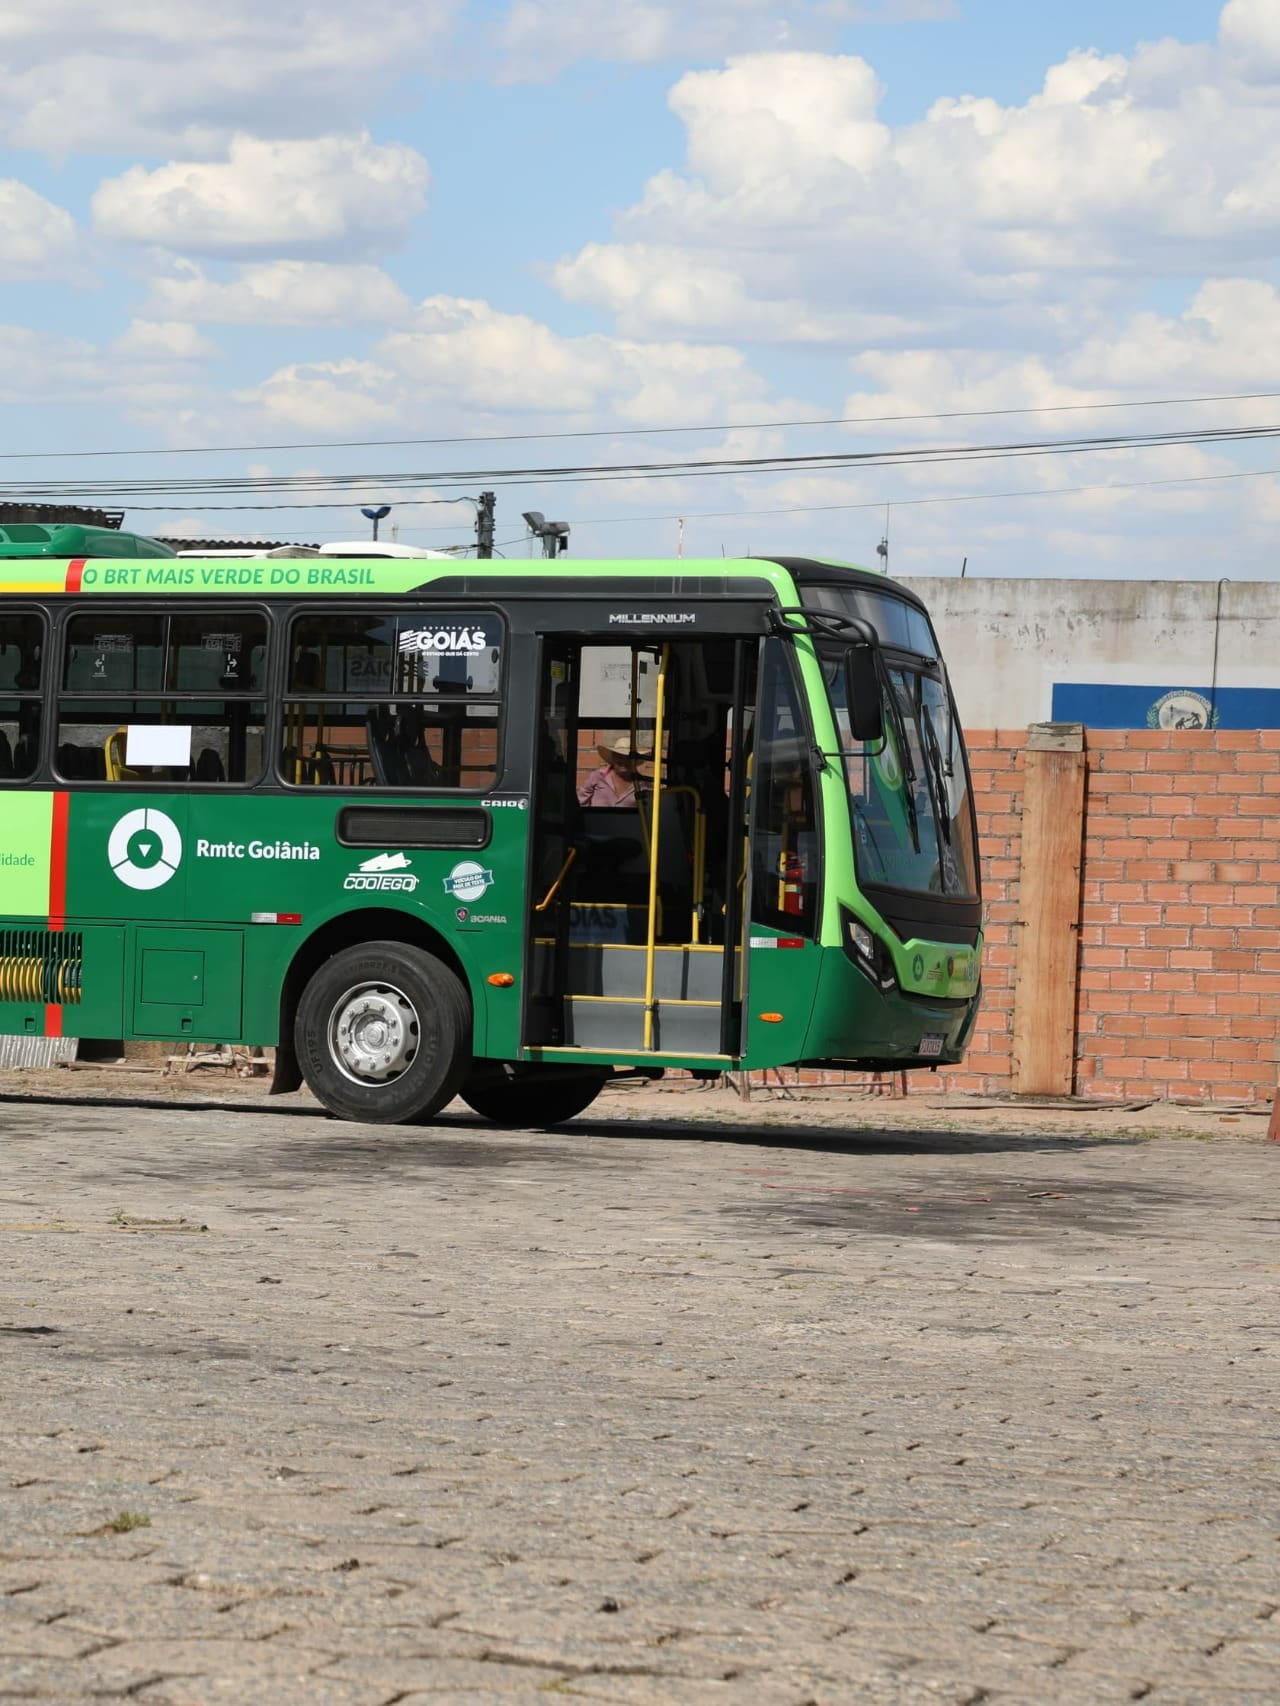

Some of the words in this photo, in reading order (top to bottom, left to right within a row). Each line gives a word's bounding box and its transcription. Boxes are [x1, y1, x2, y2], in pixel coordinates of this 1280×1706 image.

[83, 568, 98, 585] O
[104, 568, 141, 585] BRT
[146, 568, 195, 585] MAIS
[201, 568, 265, 585] VERDE
[271, 568, 301, 585] DO
[307, 568, 375, 585] BRASIL
[608, 613, 696, 624] MILLENNIUM
[416, 627, 487, 650] GOIÁS
[196, 839, 245, 858] Rmtc
[248, 840, 320, 860] Goiânia
[470, 915, 507, 924] SCANIA
